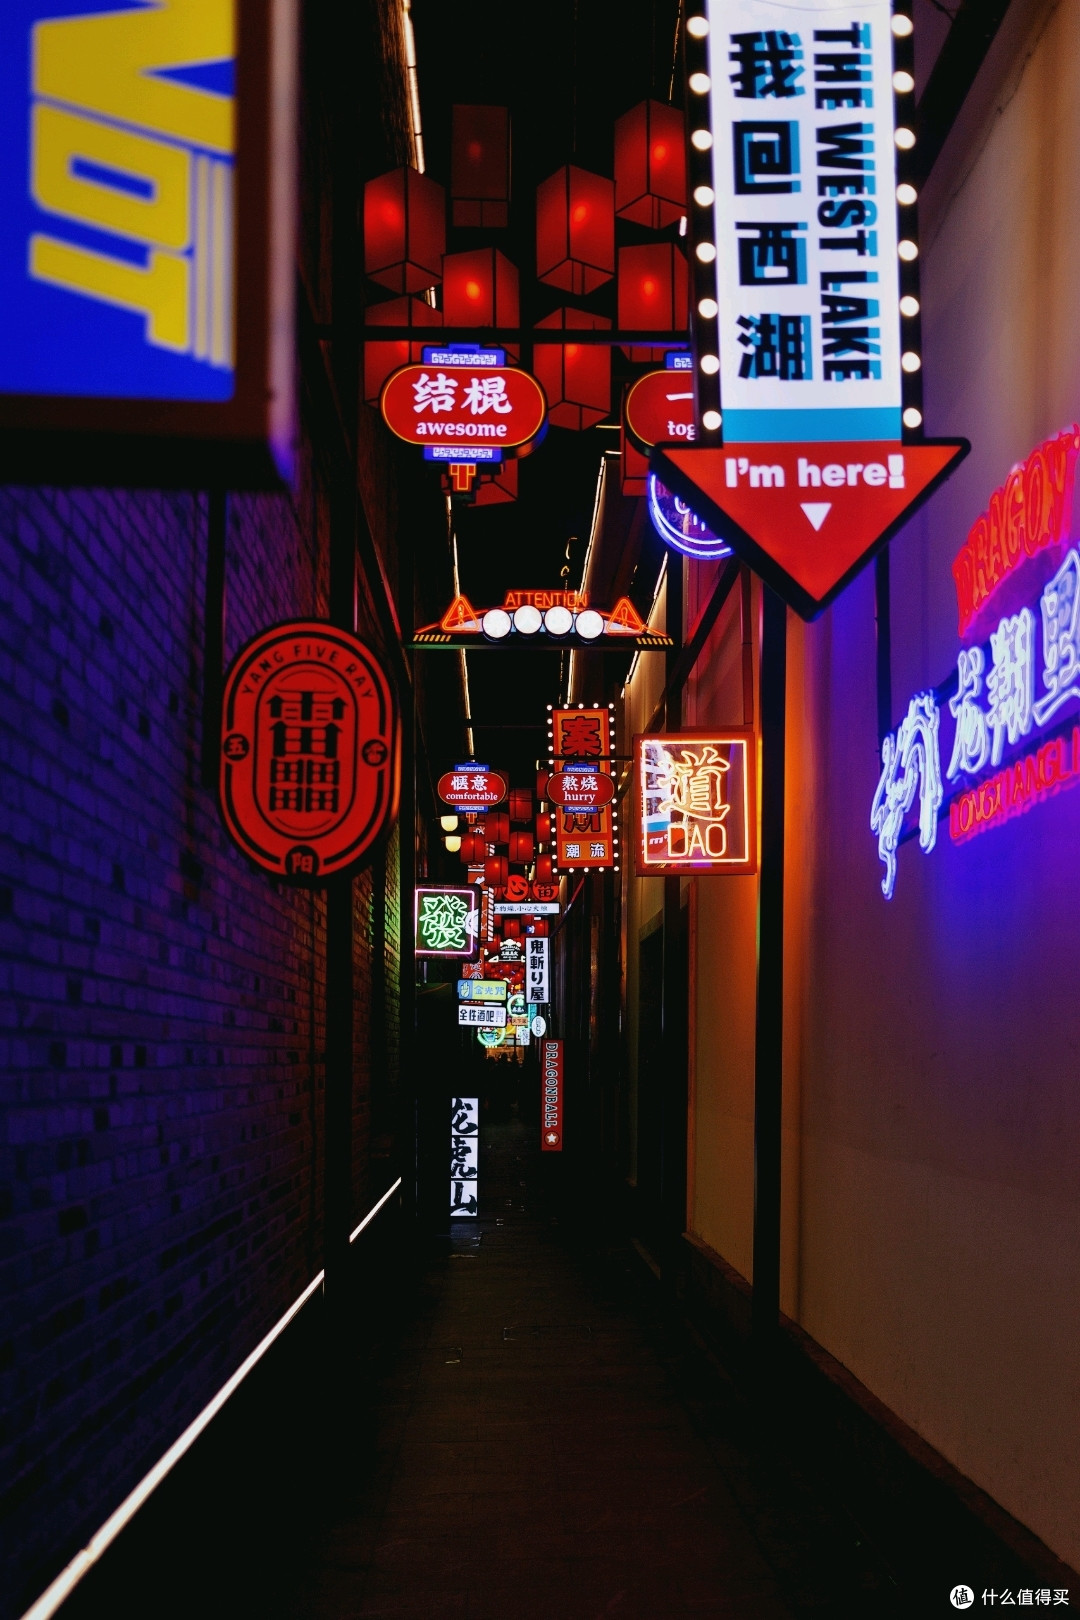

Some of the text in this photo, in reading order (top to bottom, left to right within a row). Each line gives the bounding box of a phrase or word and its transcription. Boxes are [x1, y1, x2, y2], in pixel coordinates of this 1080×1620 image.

[728, 30, 812, 381] 我回西湖
[813, 22, 882, 382] THE WEST LAKE
[412, 373, 513, 415] 结棍
[416, 422, 507, 437] awesome
[725, 454, 905, 489] I'm here!
[504, 590, 589, 609] ATTENTION
[241, 644, 374, 698] YANG FIVE RAY
[446, 791, 498, 801] comfortable
[564, 791, 595, 804] hurry
[657, 746, 731, 822] 道
[566, 843, 605, 858] 潮流
[667, 823, 727, 857] DAO
[530, 940, 545, 1001] 鬼斬り屋
[544, 1041, 559, 1128] DRAGONBALL
